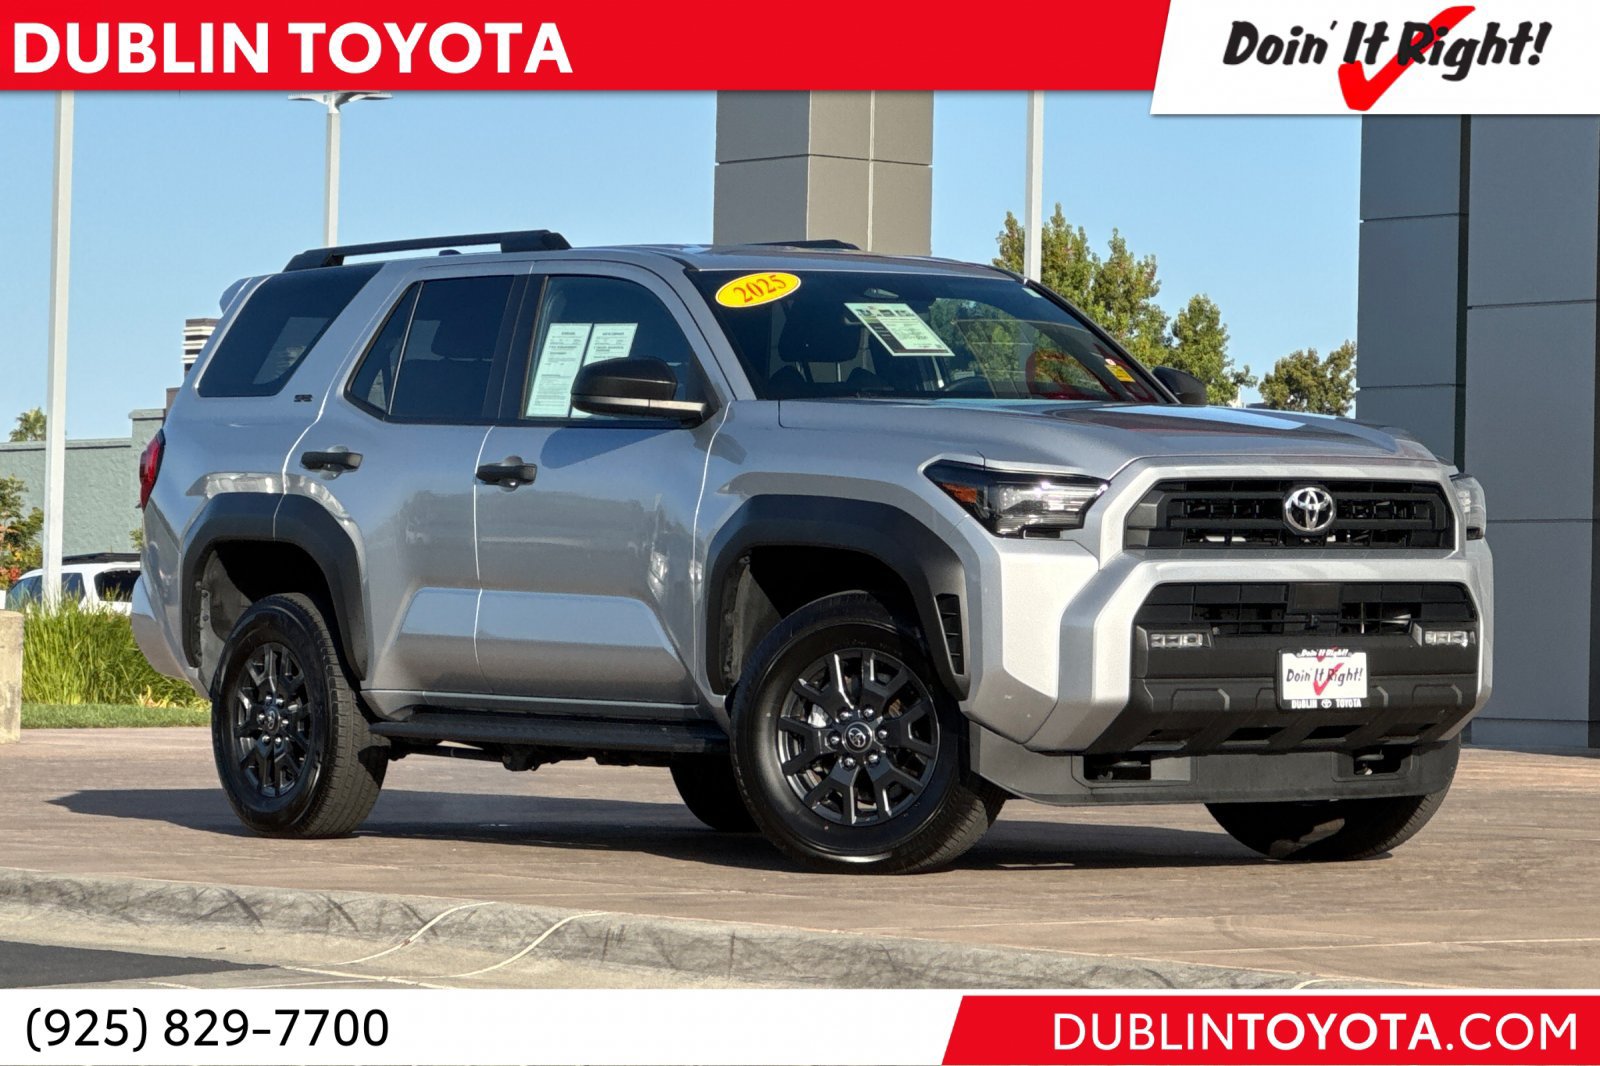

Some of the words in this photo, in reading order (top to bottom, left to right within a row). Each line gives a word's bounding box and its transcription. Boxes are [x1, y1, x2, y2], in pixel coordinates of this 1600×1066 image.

[733, 275, 787, 303] 2025
[1314, 668, 1324, 681] It
[1327, 667, 1363, 687] Right!
[1291, 698, 1318, 709] DUBLIN
[1335, 698, 1362, 708] TOYOTA
